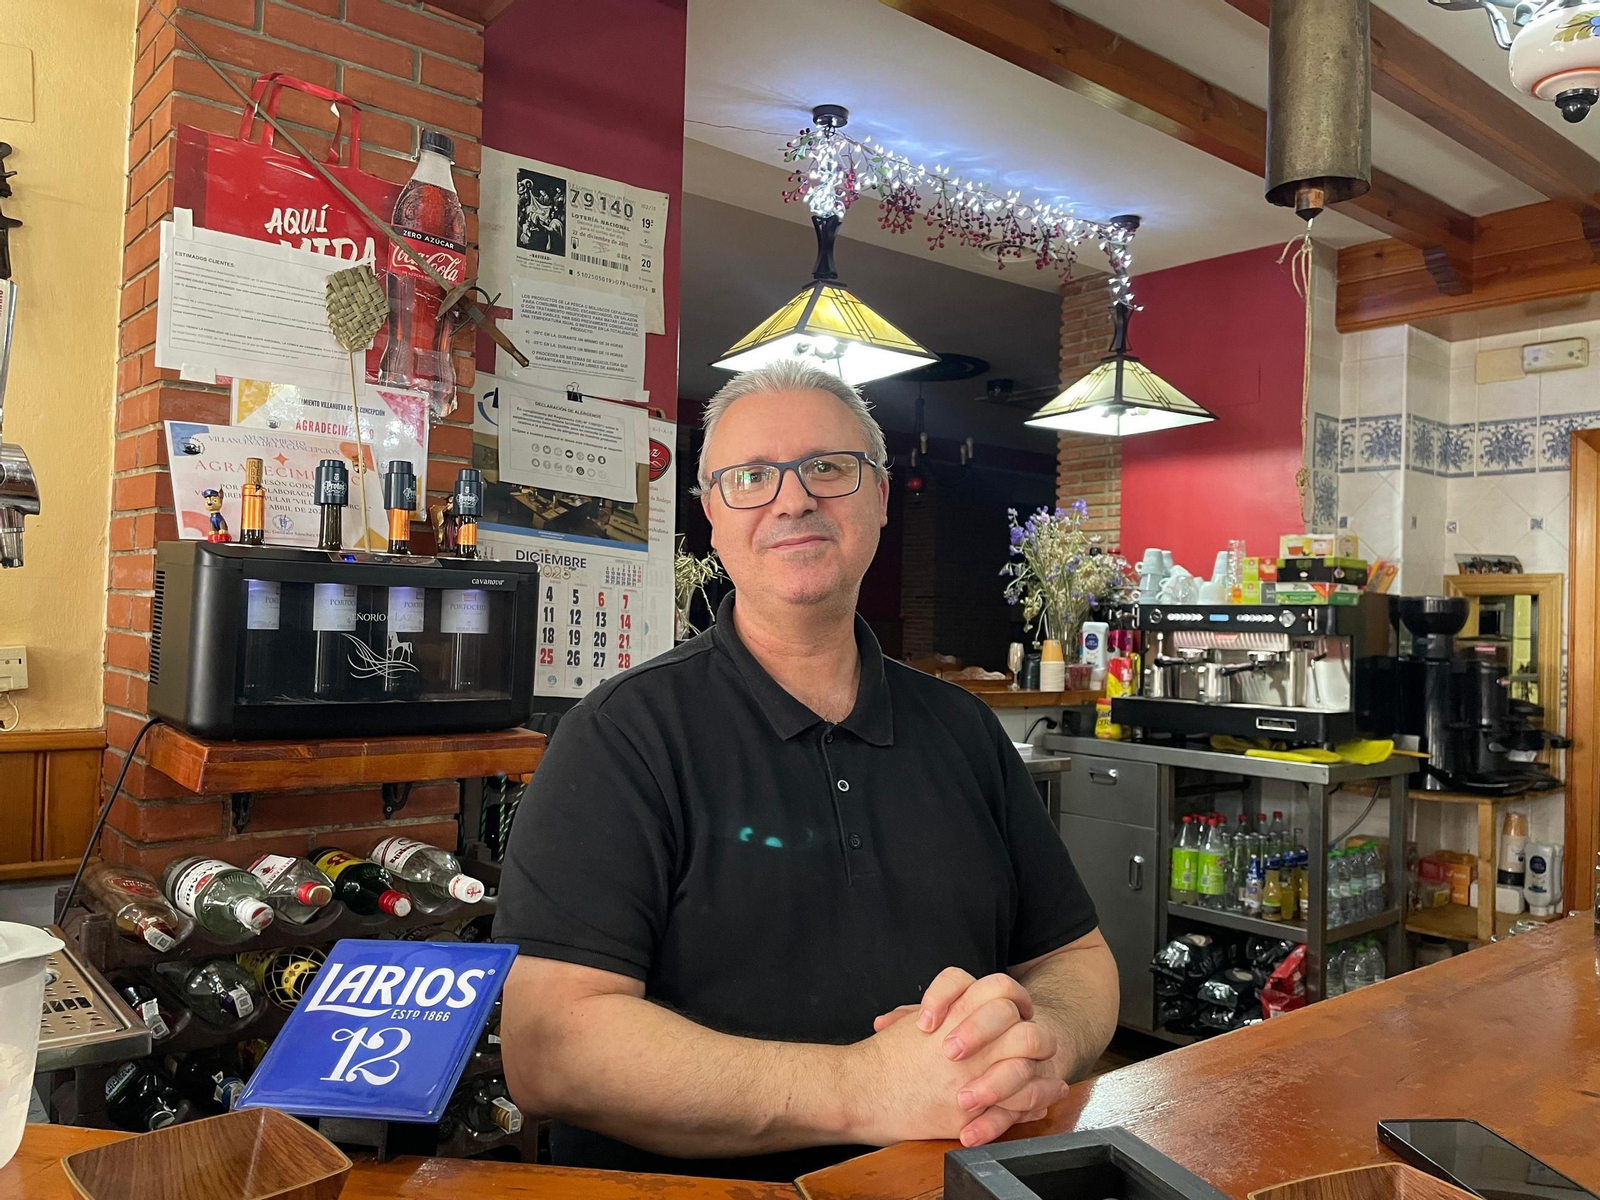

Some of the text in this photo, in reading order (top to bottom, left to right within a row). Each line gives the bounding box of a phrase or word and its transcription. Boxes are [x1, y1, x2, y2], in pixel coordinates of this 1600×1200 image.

[570, 188, 634, 219] 79140
[264, 204, 330, 236] AQUÍ
[571, 212, 631, 232] LOTERÍA NACIONAL
[403, 229, 454, 250] ZERO AZÚCAR
[586, 232, 611, 243] diciembre
[174, 250, 208, 262] ESTIMADOS
[641, 258, 652, 269] 20
[320, 400, 347, 411] VILLANUEVA
[359, 407, 385, 416] CONCEPCIÓN
[534, 401, 567, 412] DECLARACIÓN
[574, 408, 601, 419] ALÉRGENOS
[269, 505, 293, 513] ABRIL
[516, 549, 587, 569] DICIEMBRE
[546, 586, 629, 610] 4 5 6 7
[543, 606, 631, 630] 11 12 13 14
[542, 627, 630, 650] 18 19 20 21
[540, 647, 631, 669] 25 26 27 28
[304, 963, 486, 1017] LARIOS
[422, 1010, 451, 1022] 1866
[319, 1026, 412, 1086] 12
